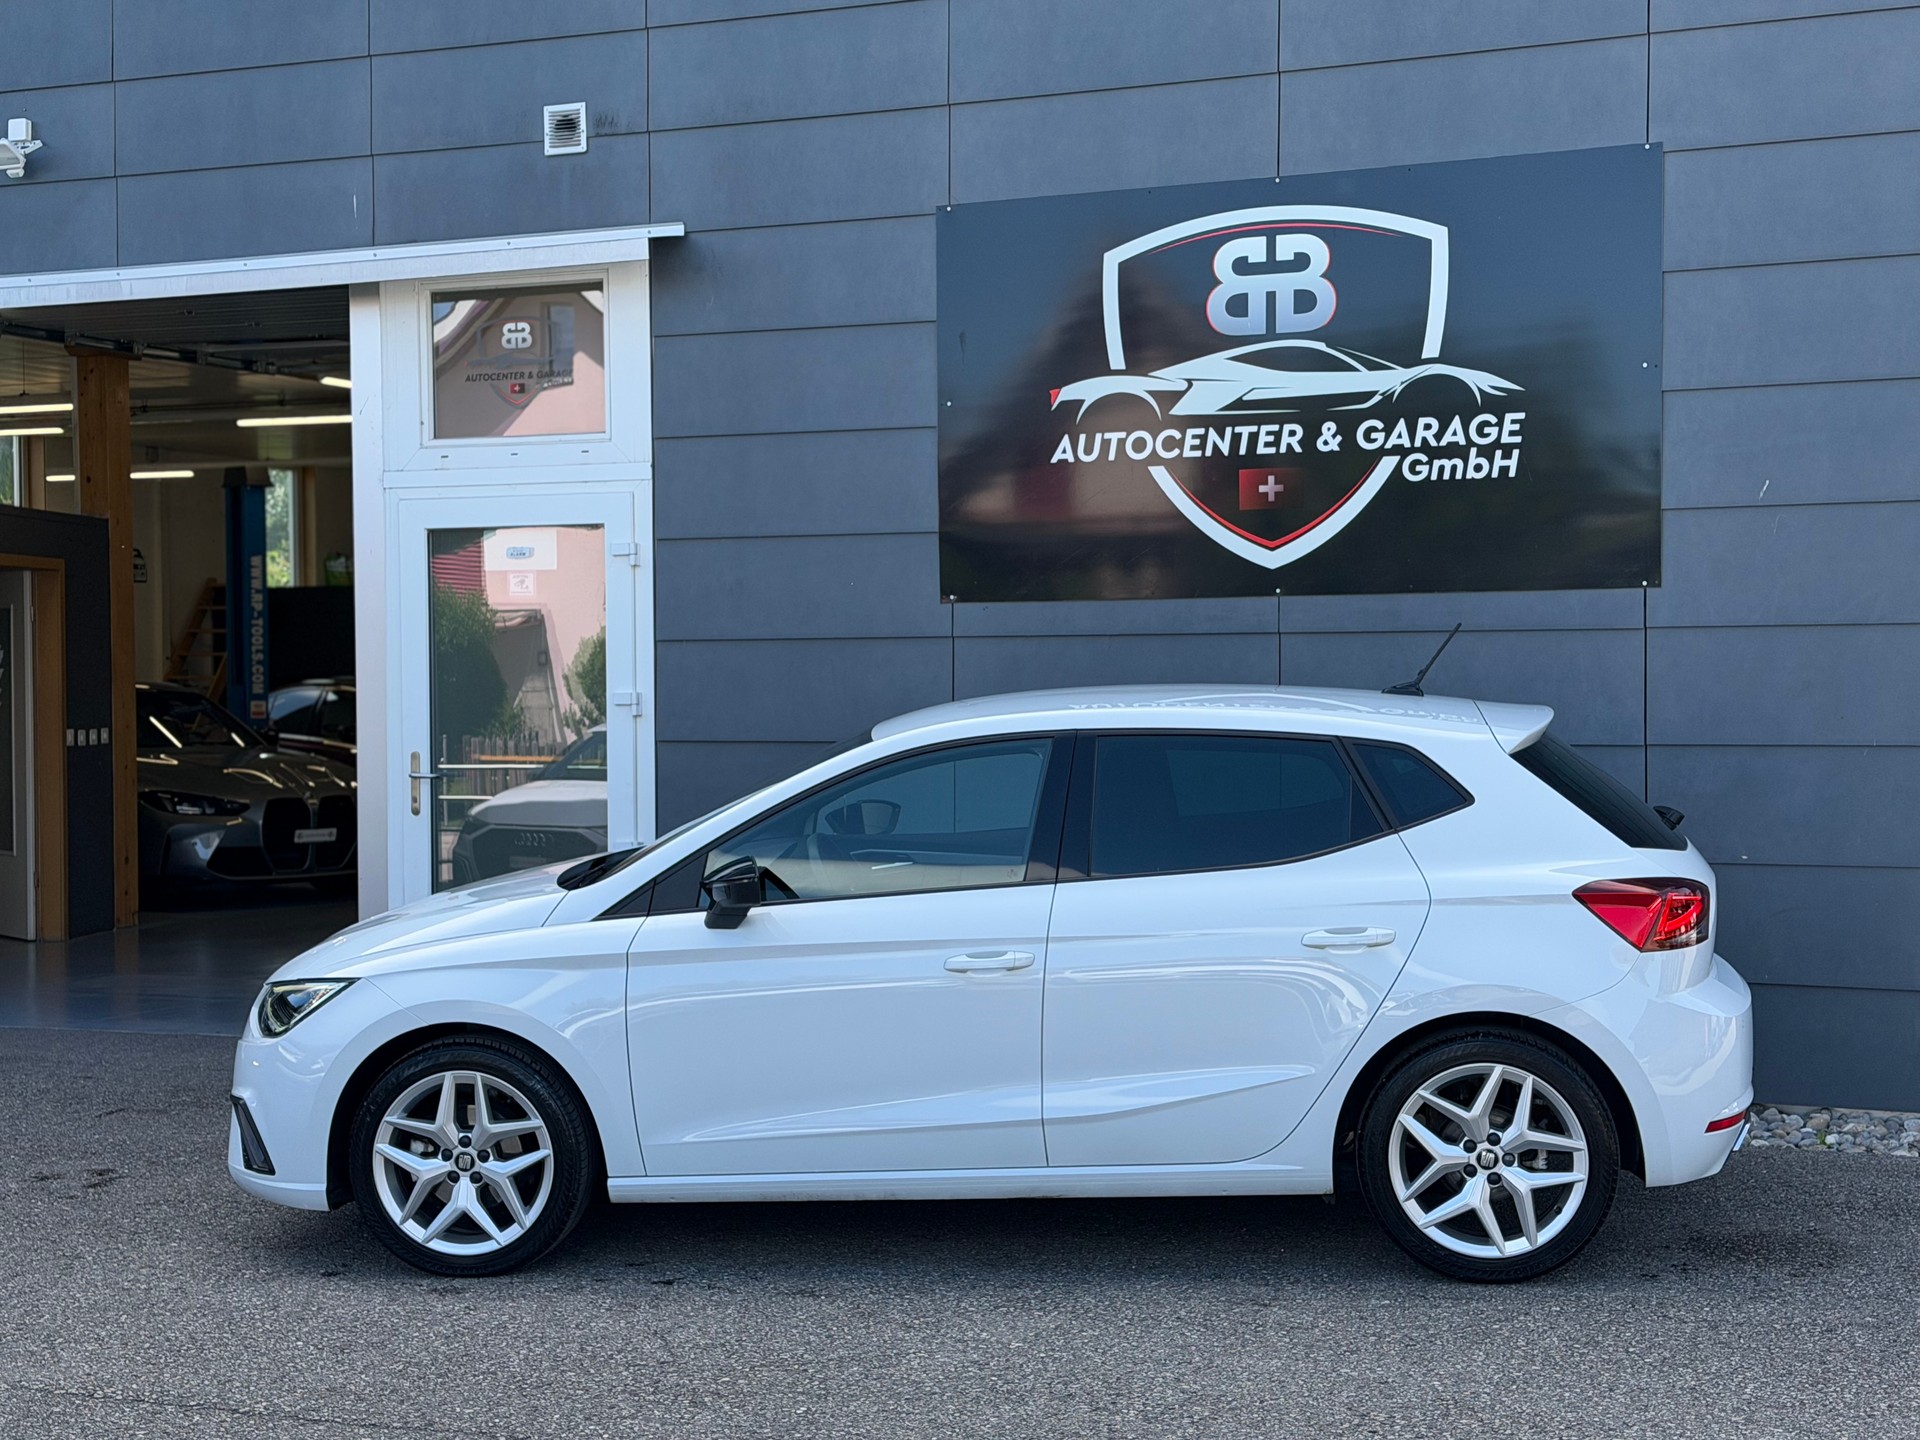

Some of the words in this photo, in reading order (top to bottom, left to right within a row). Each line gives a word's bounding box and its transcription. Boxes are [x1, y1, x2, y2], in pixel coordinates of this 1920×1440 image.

[465, 371, 525, 383] AUTOCENTER
[527, 371, 534, 380] &
[1050, 424, 1303, 463] AUTOCENTER
[1316, 421, 1343, 452] &
[1356, 412, 1526, 450] GARAGE
[1401, 447, 1520, 482] GmbH
[251, 555, 264, 694] WWW.RP-TOOLS.COM
